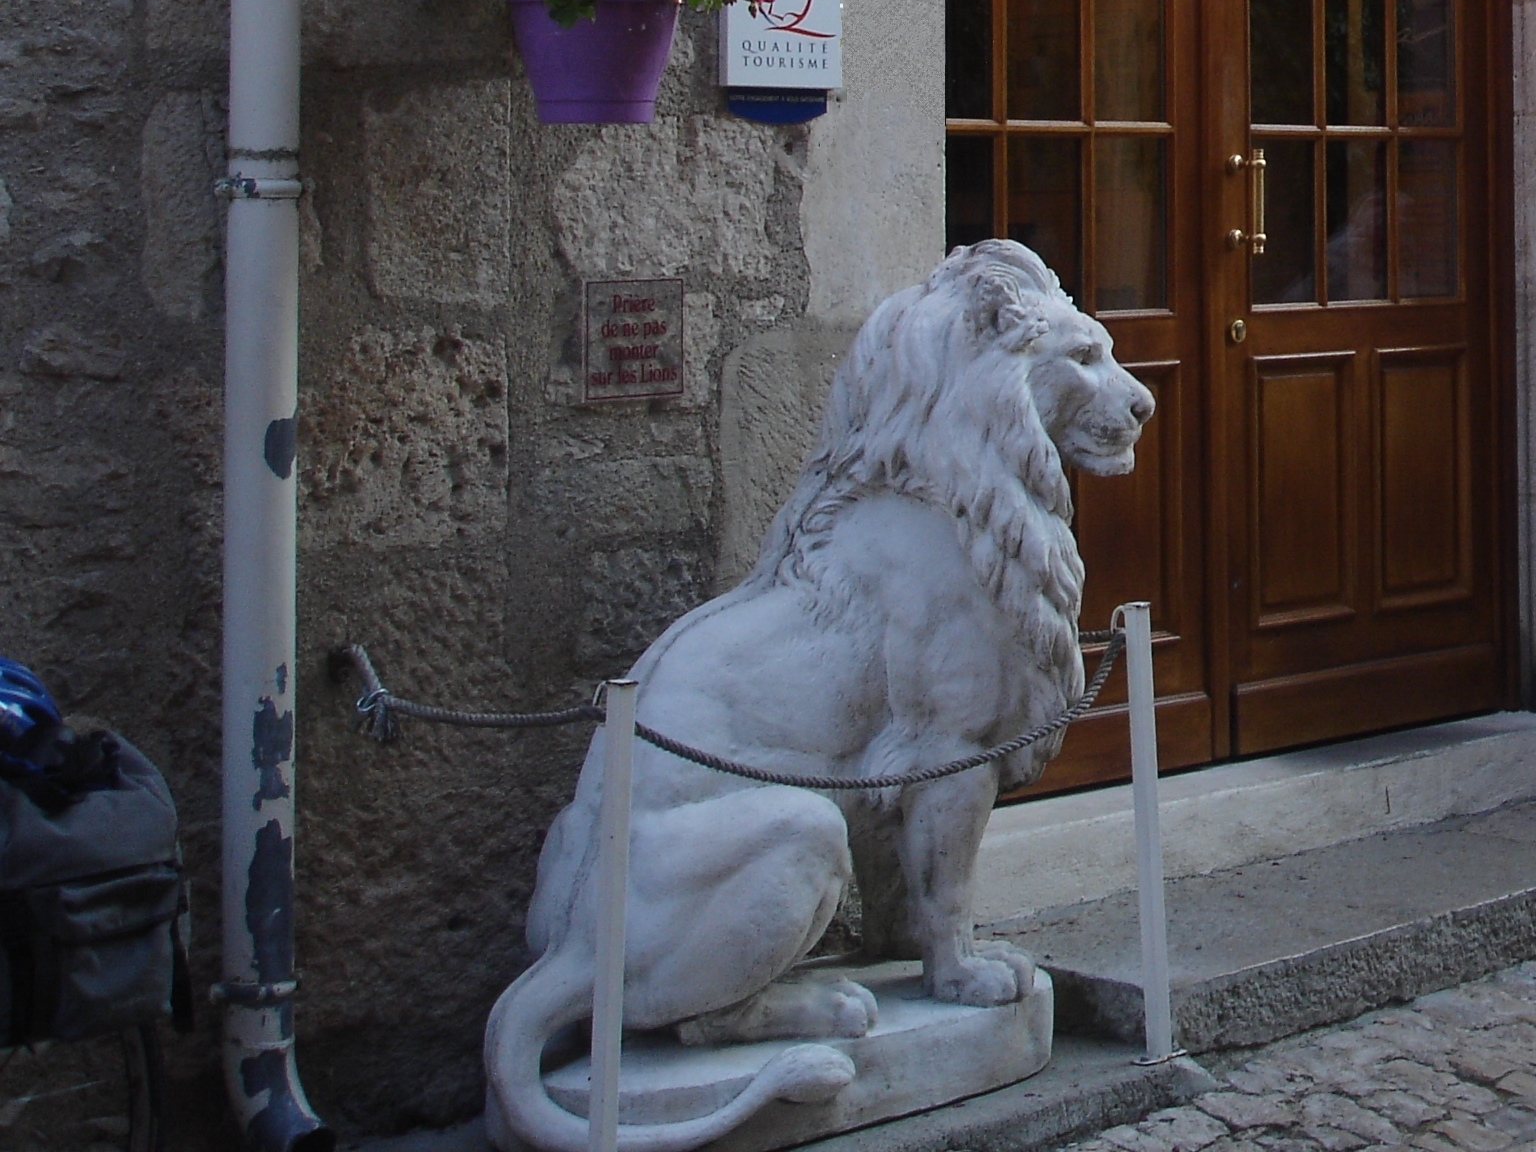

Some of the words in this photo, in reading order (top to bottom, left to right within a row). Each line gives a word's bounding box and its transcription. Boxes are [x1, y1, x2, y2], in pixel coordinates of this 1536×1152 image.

[742, 39, 829, 54] QUALITÉ
[742, 55, 829, 70] TOURISME
[612, 293, 656, 314] Prière
[601, 319, 619, 338] de
[622, 322, 640, 338] ne
[643, 319, 668, 340] pas
[608, 344, 660, 361] monter
[590, 371, 613, 386] sur
[617, 364, 637, 385] les
[640, 363, 678, 384] Lions
